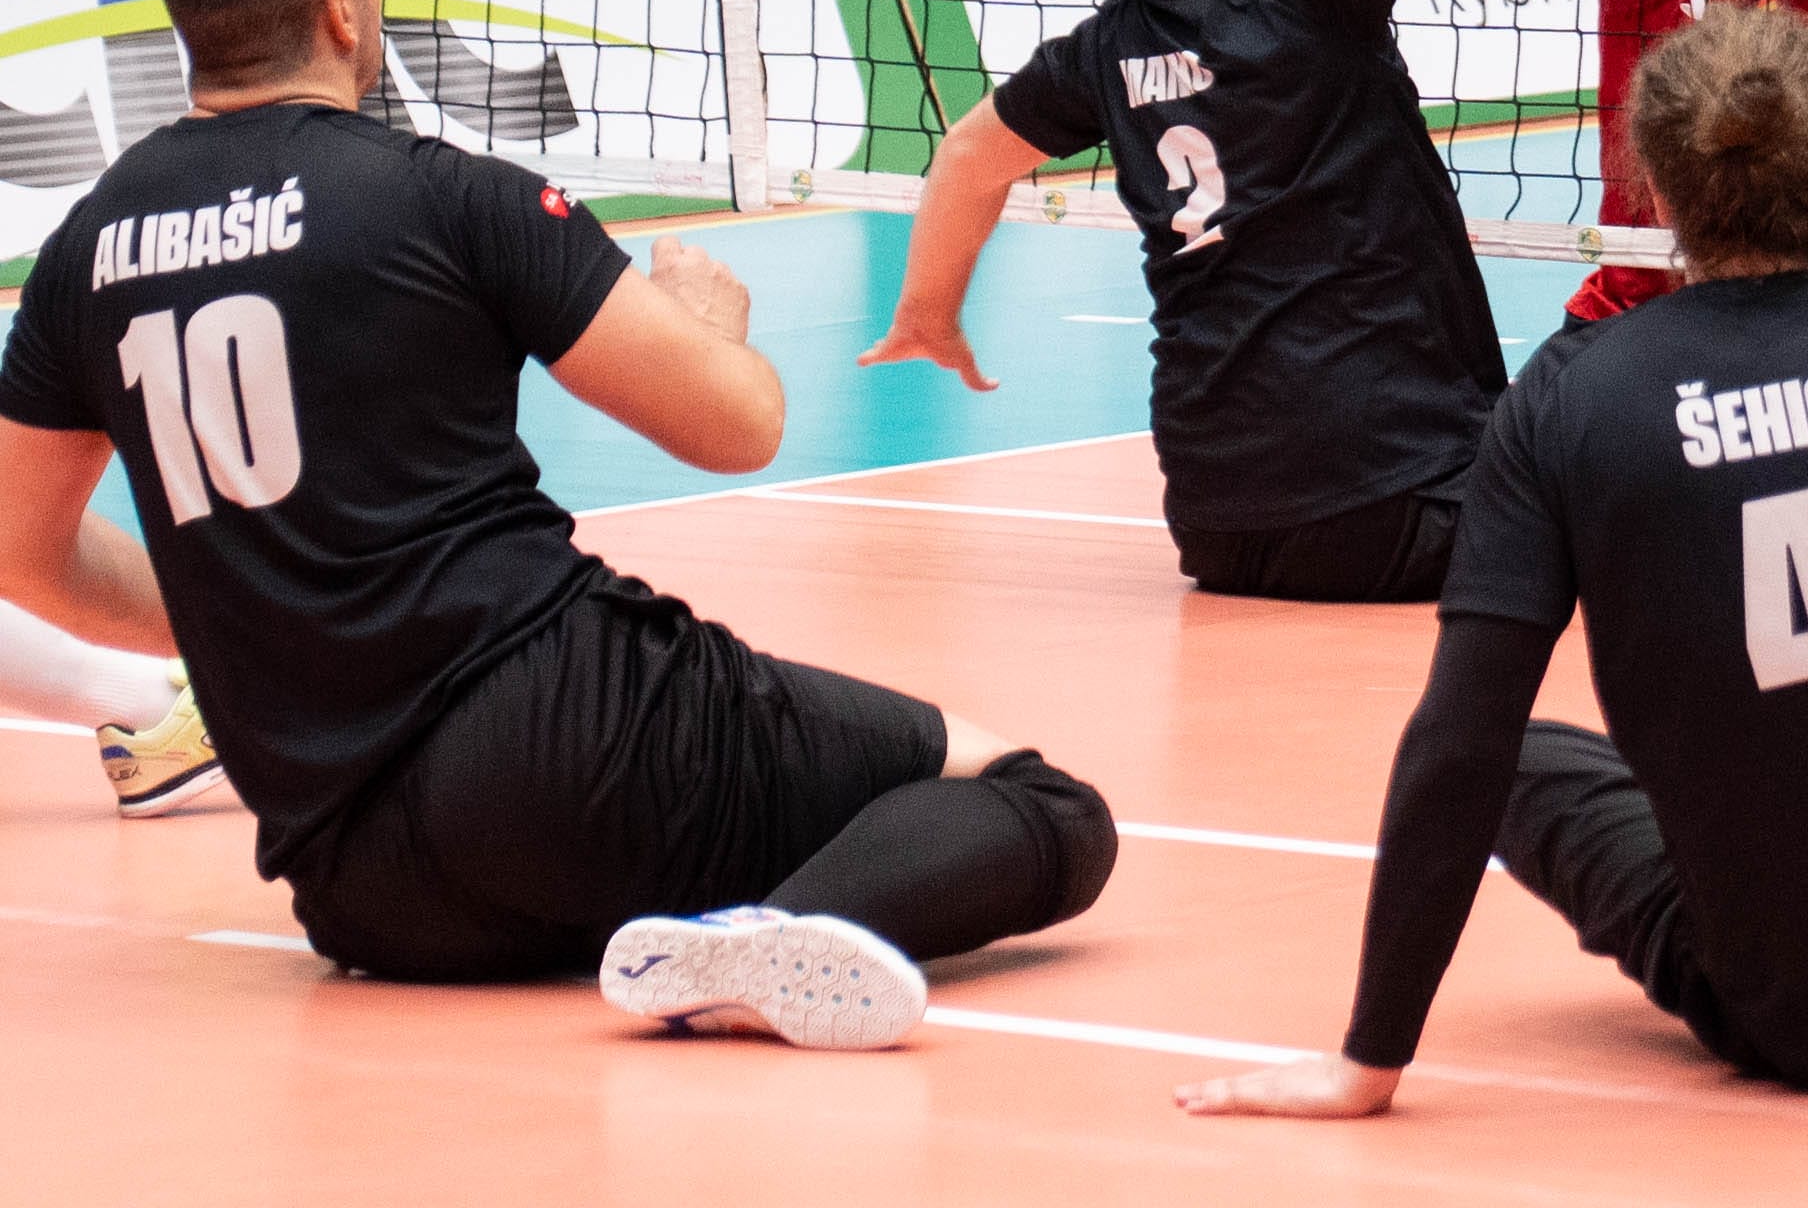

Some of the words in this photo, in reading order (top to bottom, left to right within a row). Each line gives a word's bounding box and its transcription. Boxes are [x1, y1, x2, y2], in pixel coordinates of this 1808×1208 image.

[92, 177, 305, 293] ALIBAŠIĆ
[1156, 124, 1227, 256] 2
[117, 293, 303, 527] 10
